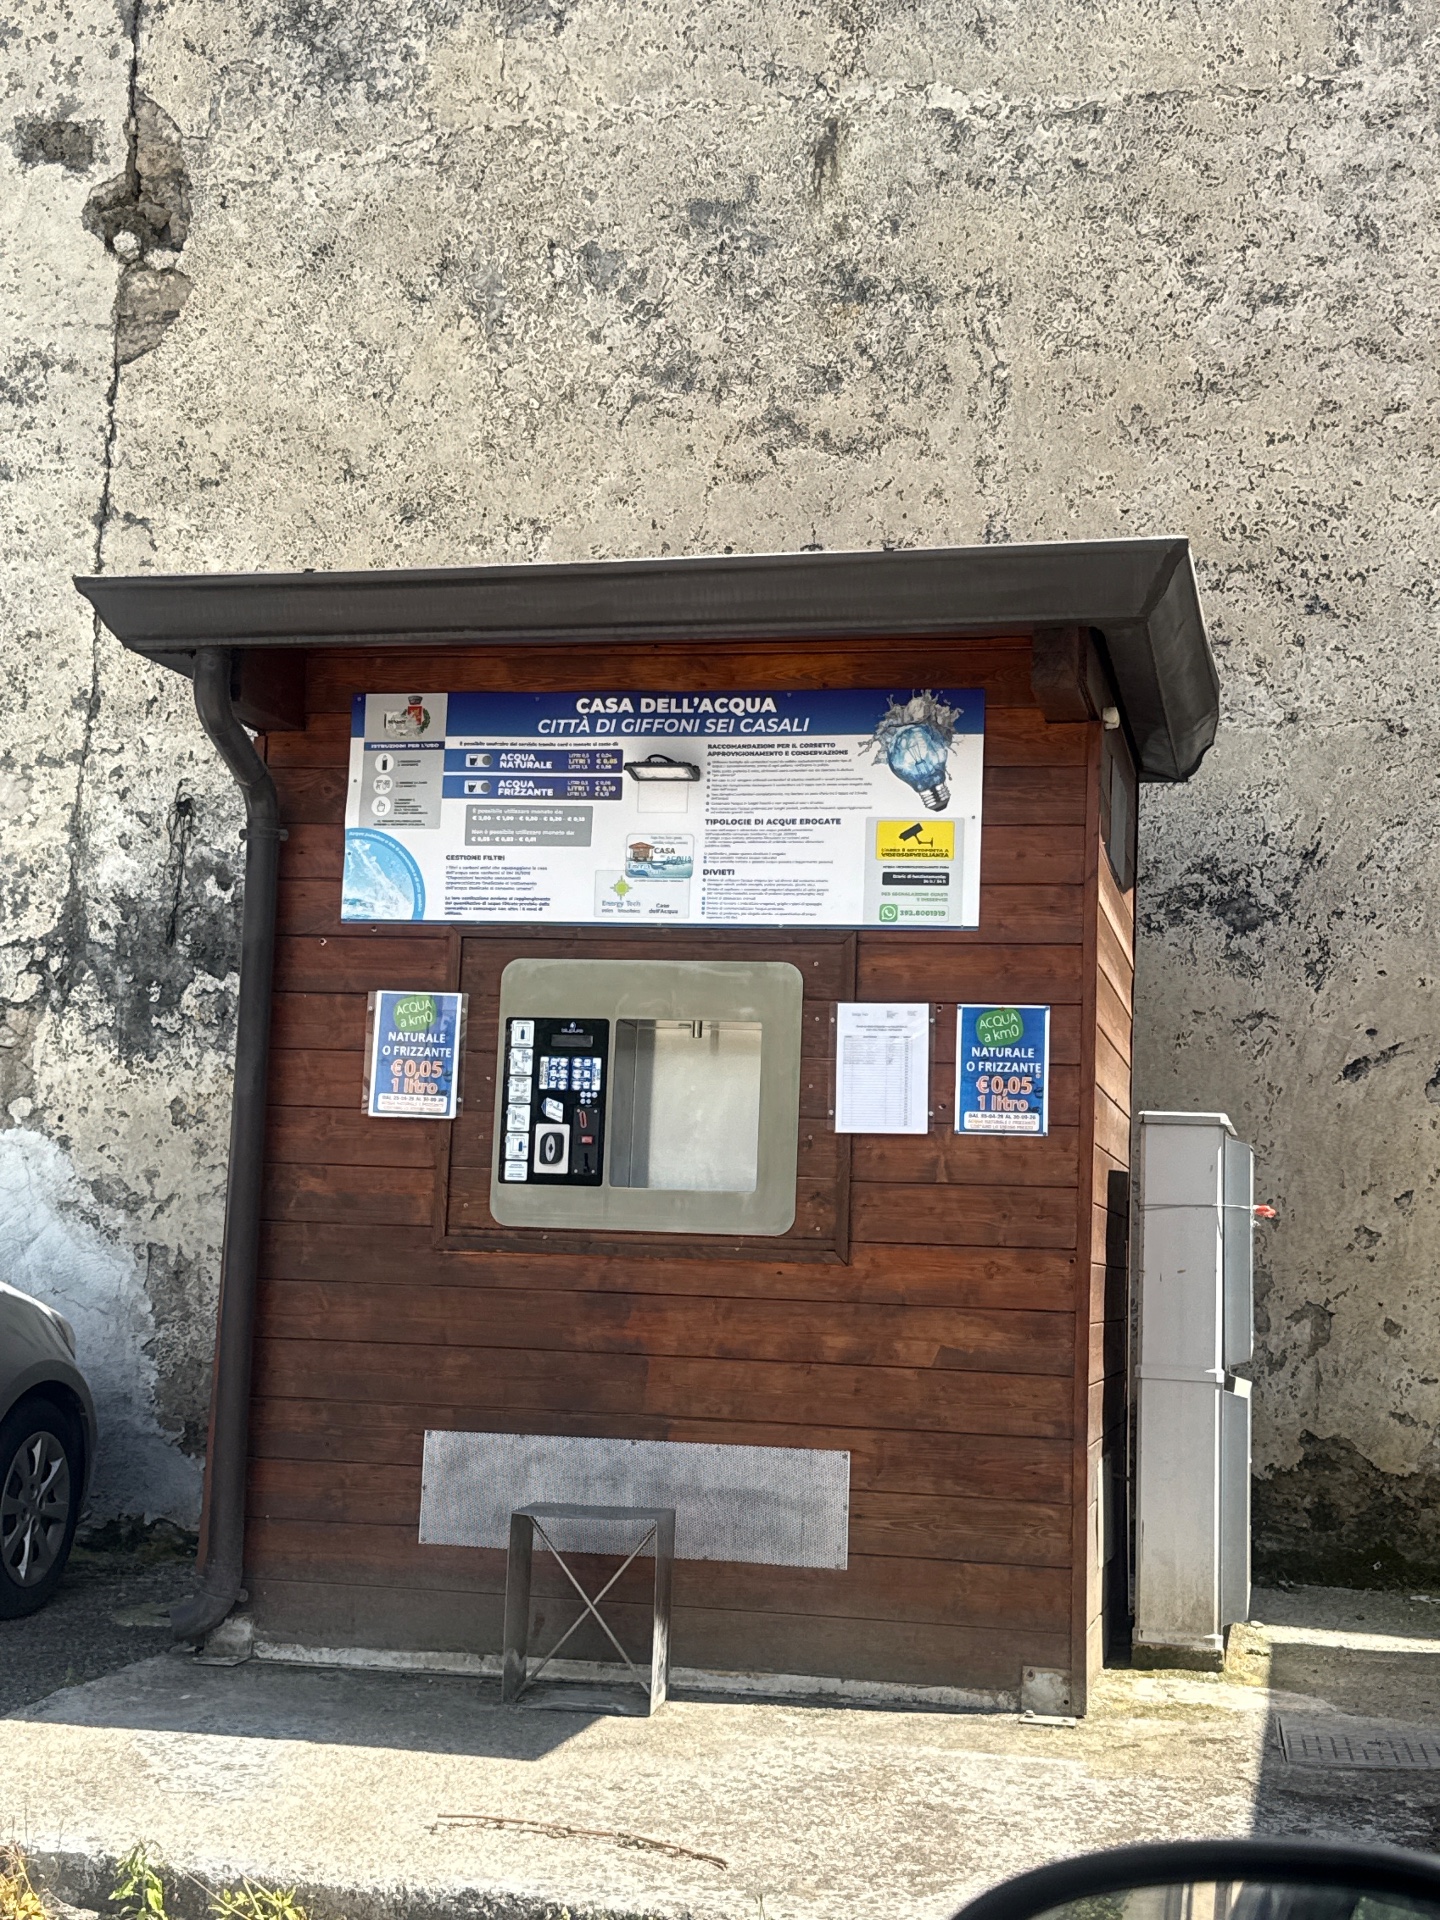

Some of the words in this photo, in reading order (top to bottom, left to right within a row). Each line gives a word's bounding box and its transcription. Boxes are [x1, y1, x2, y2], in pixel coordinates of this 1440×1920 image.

[575, 698, 633, 714] CASA
[640, 697, 777, 717] DELL'ACQUA
[537, 716, 591, 734] CITTÀ
[595, 718, 616, 734] DI
[621, 718, 700, 734] GIFFONI
[704, 718, 735, 733] SEI
[739, 717, 810, 733] CASALI
[499, 761, 553, 769] NATURALE
[500, 753, 536, 764] ACQUA
[498, 780, 535, 790] ACQUA
[497, 788, 554, 796] FRIZZANTE
[766, 818, 797, 826] ACQUE
[601, 900, 624, 908] Energy
[396, 999, 432, 1016] ACQUA
[400, 1019, 407, 1028] a
[408, 1010, 433, 1027] km0
[980, 1012, 1018, 1030] ACQUA
[388, 1031, 446, 1044] NATURALE
[984, 1033, 991, 1043] a
[993, 1024, 1019, 1041] km0
[382, 1045, 391, 1055] O
[393, 1046, 452, 1058] FRIZZANTE
[971, 1047, 1035, 1058] NATURALE
[966, 1061, 975, 1072] O
[978, 1061, 1042, 1073] FRIZZANTE
[391, 1078, 399, 1093] 1
[403, 1077, 438, 1094] litro
[977, 1095, 985, 1110] 1
[991, 1094, 1029, 1112] litro
